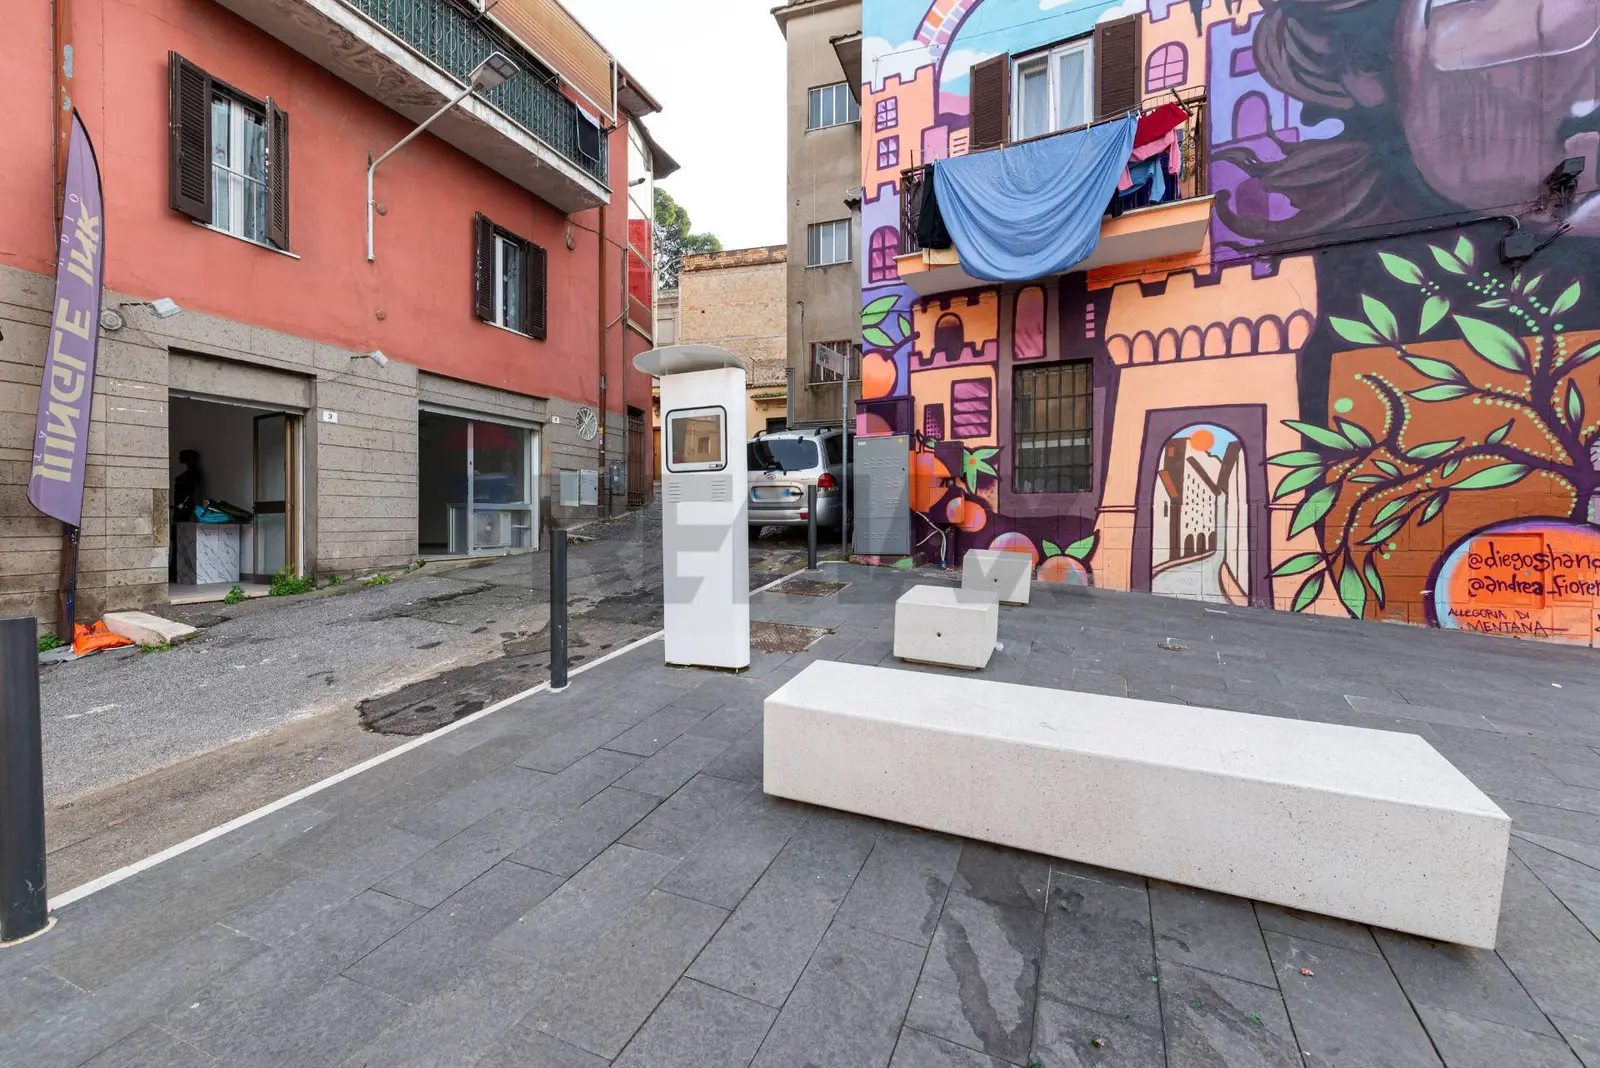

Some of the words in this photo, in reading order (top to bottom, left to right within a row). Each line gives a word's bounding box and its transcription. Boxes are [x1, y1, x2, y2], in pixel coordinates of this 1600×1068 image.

[1447, 607, 1507, 619] ALLEGORIA
[1515, 610, 1530, 619] DI
[1466, 620, 1550, 637] MENTANA
